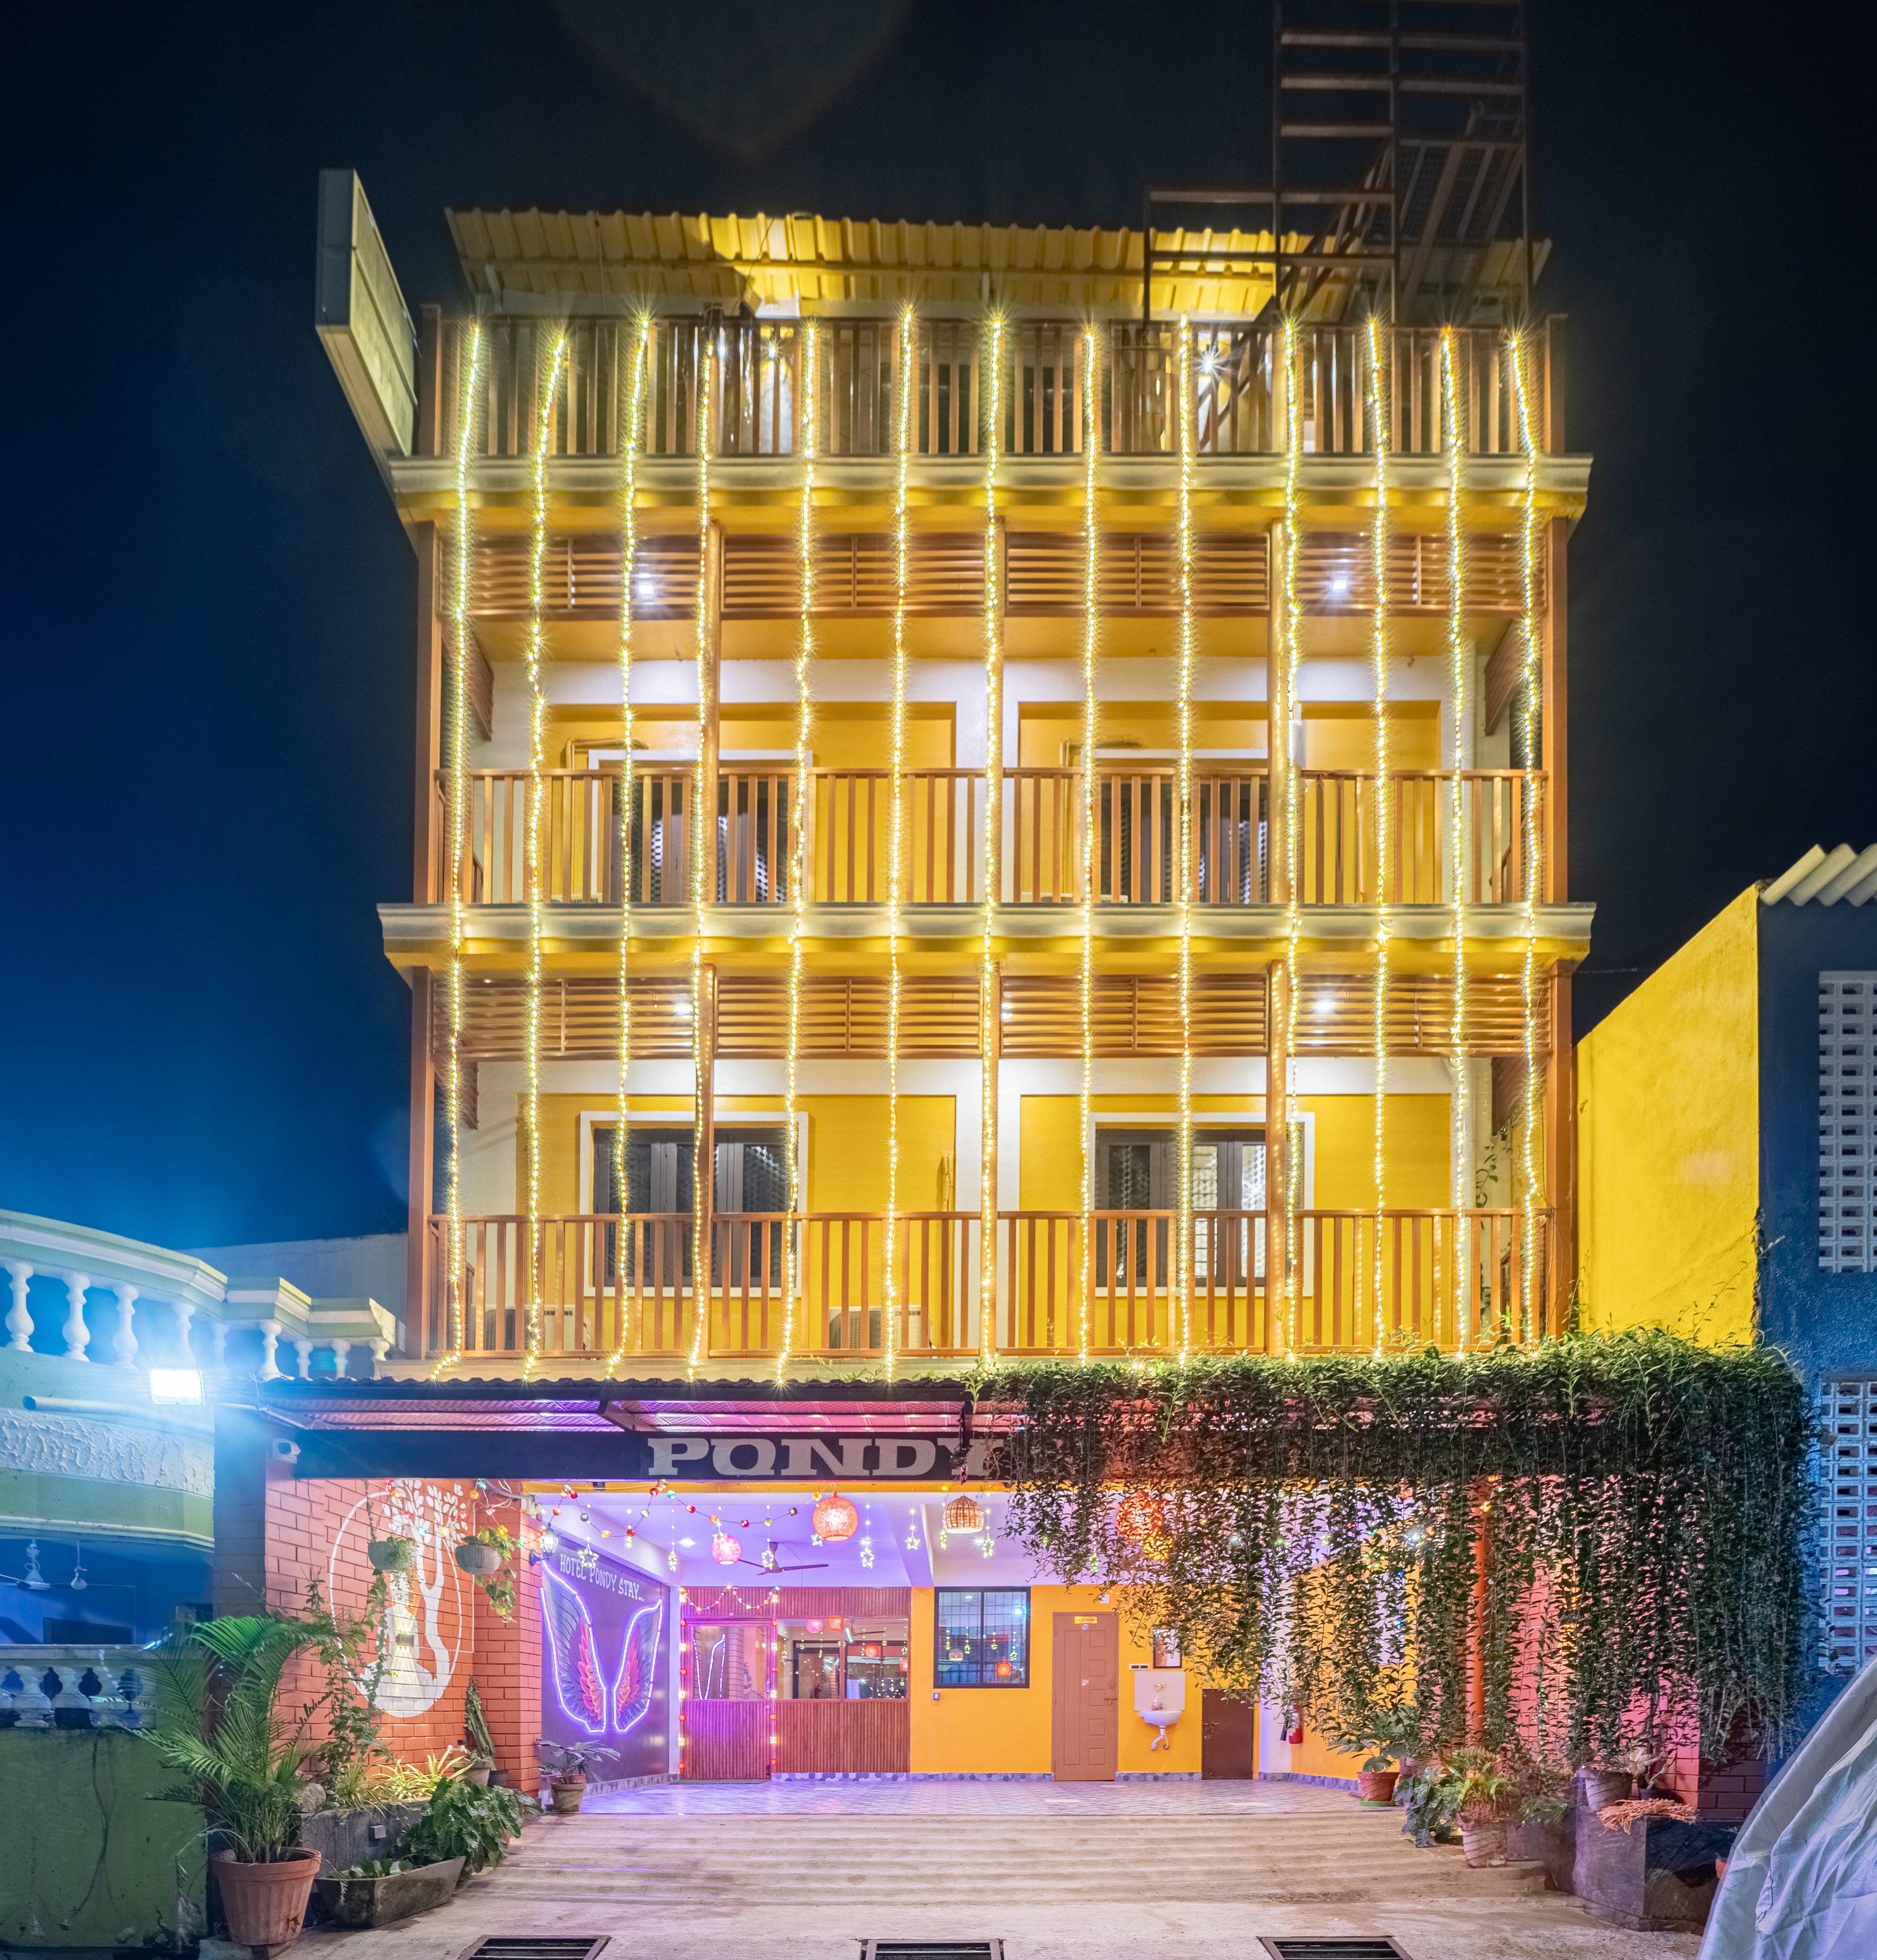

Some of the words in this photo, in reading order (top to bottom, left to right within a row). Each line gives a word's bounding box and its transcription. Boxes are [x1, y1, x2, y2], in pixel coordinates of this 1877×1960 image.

[647, 1437, 1004, 1476] PONDY
[560, 1553, 587, 1580] HOTEL
[589, 1567, 618, 1592] PONDY
